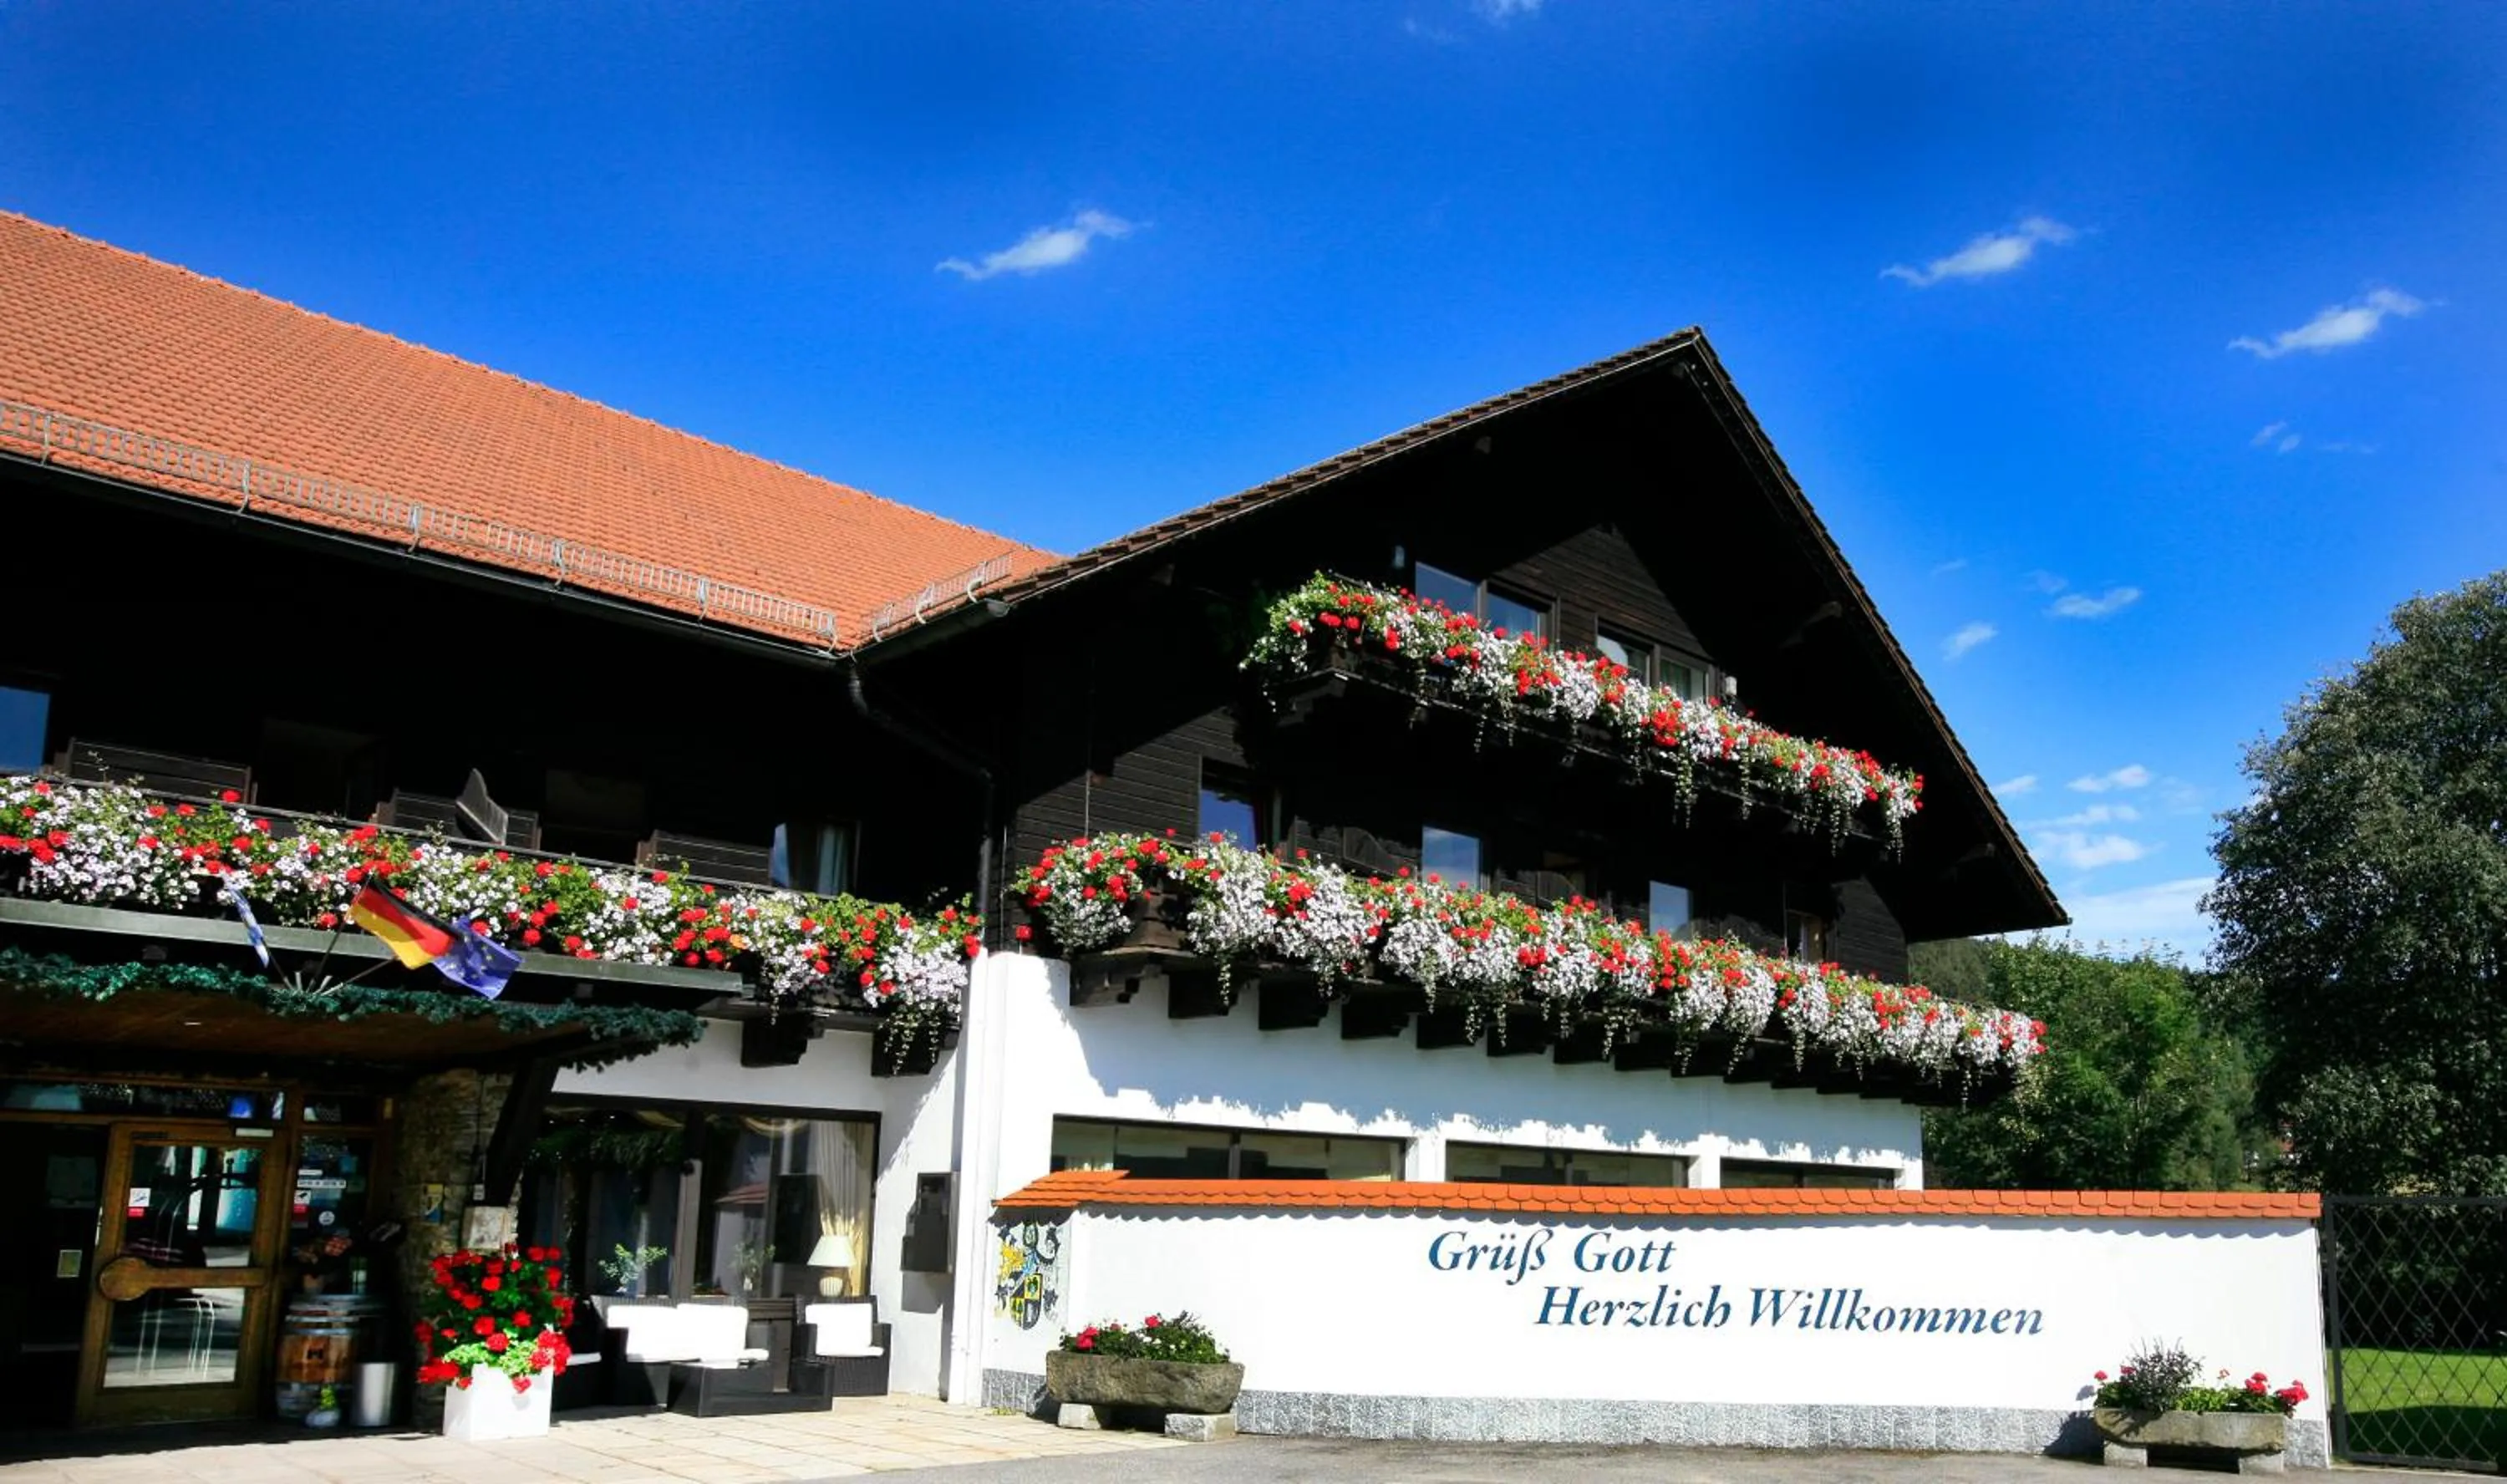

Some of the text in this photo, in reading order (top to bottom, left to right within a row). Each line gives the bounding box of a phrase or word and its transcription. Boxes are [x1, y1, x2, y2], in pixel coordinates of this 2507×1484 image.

[1427, 1228, 1677, 1286] Grüß Gott
[1534, 1284, 2044, 1336] Herzlich Willkommen
